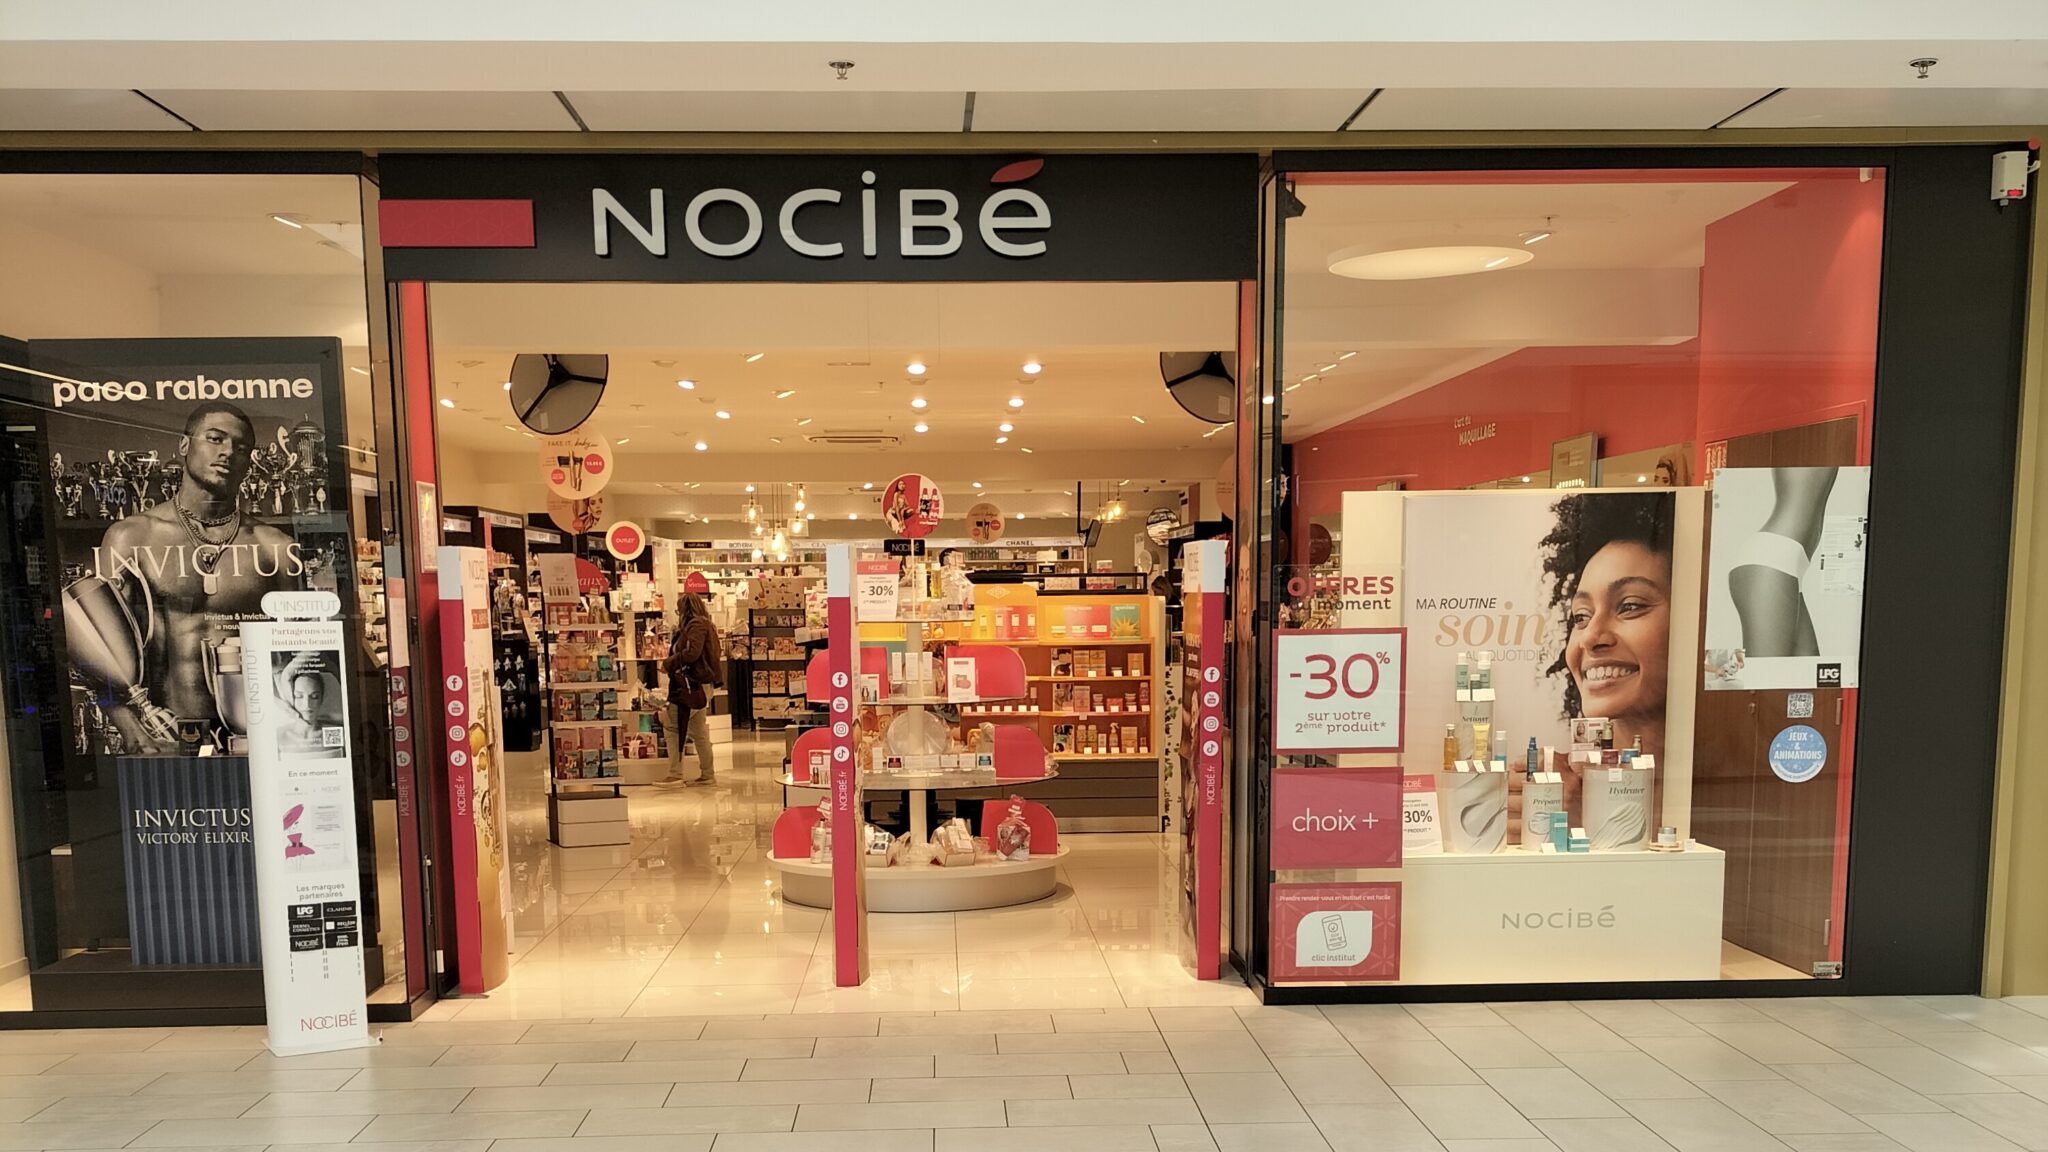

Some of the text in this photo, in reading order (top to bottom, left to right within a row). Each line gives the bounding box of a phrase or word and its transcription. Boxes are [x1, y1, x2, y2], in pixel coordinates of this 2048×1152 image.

[53, 375, 314, 407] paco rabanne
[1459, 422, 1496, 446] MAQUILLAGE
[92, 543, 304, 580] INVICTUS
[1287, 576, 1395, 597] OFFRES
[273, 600, 338, 612] L'INSTITUT
[1317, 598, 1392, 610] moment
[1416, 598, 1497, 610] MA ROUTINE
[204, 612, 271, 621] Invictus & Invictus
[1434, 601, 1546, 648] soin
[1289, 651, 1391, 700] -30%
[1818, 668, 1840, 679] LPG
[246, 649, 261, 714] L'INSTITUT
[1307, 710, 1372, 721] sur votre
[1295, 722, 1323, 733] 2ème
[1787, 731, 1808, 742] JEUX
[1794, 742, 1801, 750] &
[1773, 750, 1823, 761] ANIMATIONS
[288, 770, 298, 778] En
[134, 808, 251, 828] INVICTUS
[1292, 807, 1357, 832] choix
[136, 831, 252, 845] VICTORY ELIXIR
[296, 883, 345, 893] Les marques
[299, 891, 343, 902] partenaires
[296, 906, 314, 915] LPG
[1311, 953, 1356, 962] clic institut
[300, 1009, 358, 1032] NOCIBÉ
